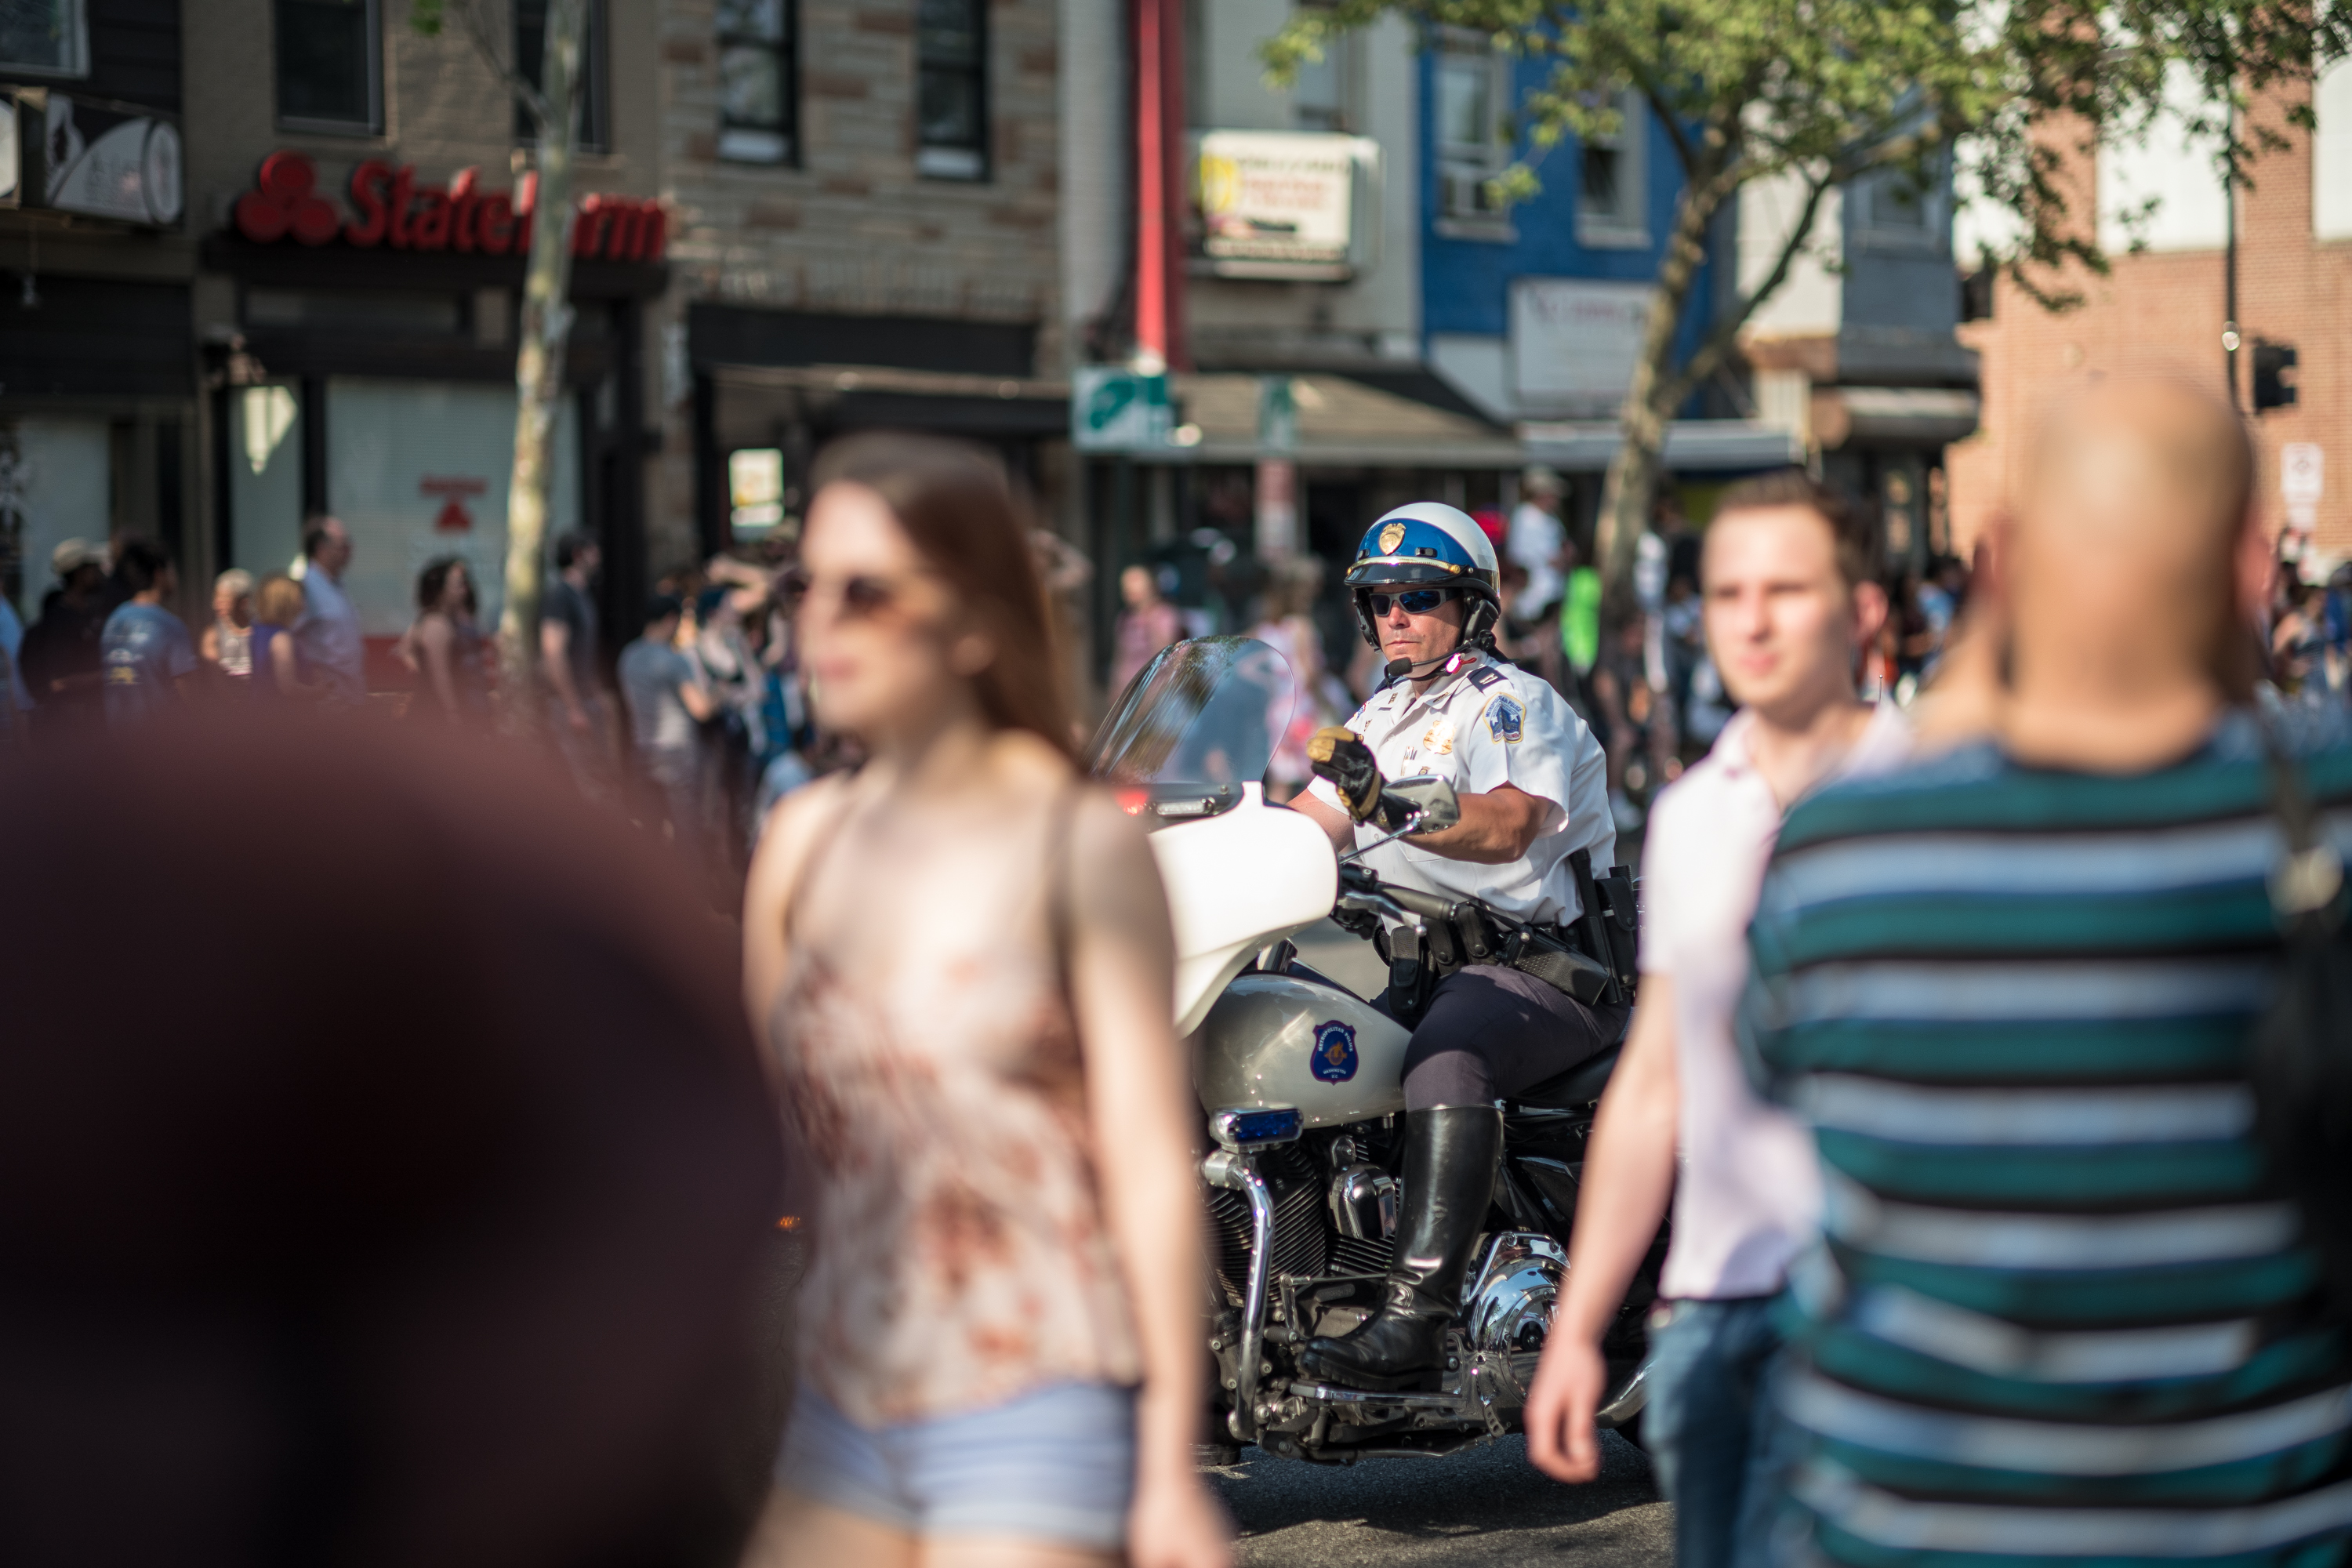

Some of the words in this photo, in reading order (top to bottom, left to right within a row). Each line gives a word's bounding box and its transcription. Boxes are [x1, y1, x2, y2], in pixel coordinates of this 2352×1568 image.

[517, 169, 666, 262] rm
[1318, 1026, 1345, 1051] METROPOLITAN
[1344, 1032, 1353, 1052] POLICE
